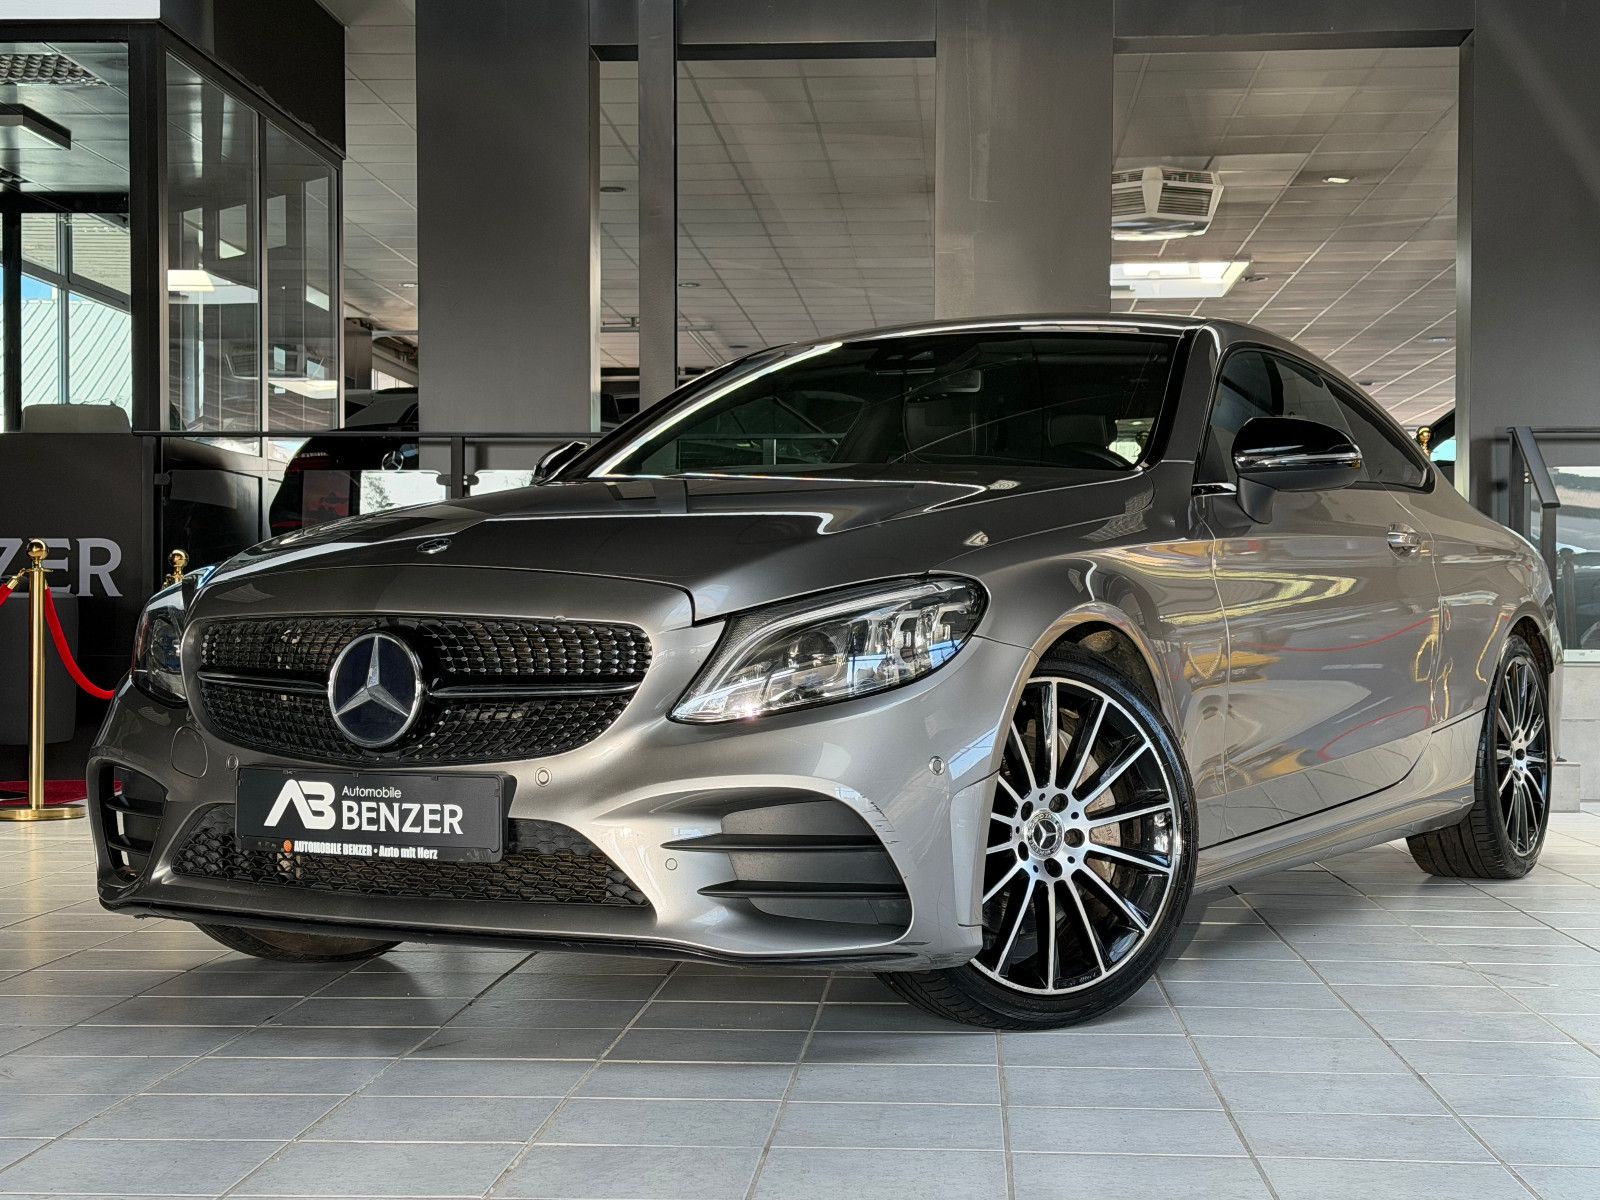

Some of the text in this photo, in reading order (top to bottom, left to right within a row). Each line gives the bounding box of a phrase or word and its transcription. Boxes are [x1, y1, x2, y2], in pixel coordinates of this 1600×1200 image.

[263, 779, 336, 830] AB
[341, 785, 402, 799] Automobile
[341, 801, 464, 835] BENZER
[294, 840, 438, 860] AUTOMOBILE BENZER Auto mit Herz
